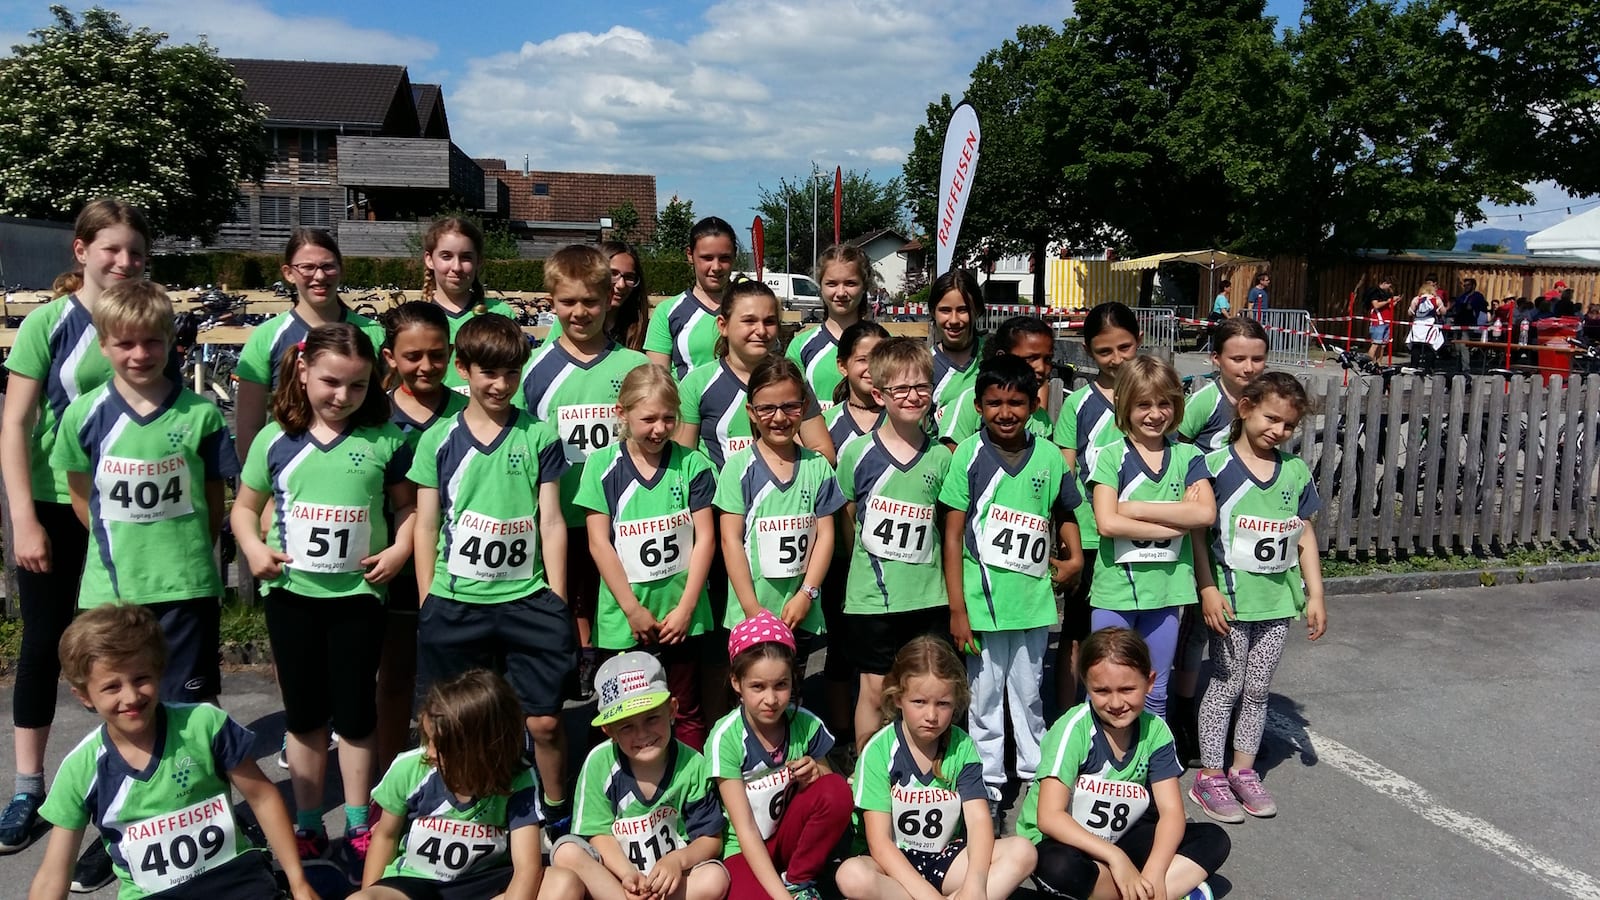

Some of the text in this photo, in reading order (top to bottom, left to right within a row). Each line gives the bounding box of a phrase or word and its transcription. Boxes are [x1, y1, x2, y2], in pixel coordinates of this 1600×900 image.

[938, 130, 977, 247] RAIFFEISEN
[103, 456, 185, 476] RAIFFEISEN
[109, 475, 183, 509] 404
[461, 514, 534, 536] RAIFFEISEN
[619, 512, 691, 537] RAIFFEISEN
[873, 518, 927, 551] 411
[306, 527, 350, 558] 51
[459, 535, 527, 569] 408
[640, 534, 680, 567] 65
[779, 534, 809, 564] 59
[991, 528, 1046, 564] 410
[1139, 550, 1157, 558] Jugitag
[1254, 536, 1289, 562] 61
[1076, 776, 1147, 800] RAIFFEISEN
[127, 799, 225, 841] RAIFFEISEN
[417, 816, 503, 838] RAIFFEISEN
[898, 808, 943, 839] 68
[1086, 799, 1130, 832] 58
[141, 825, 225, 877] 409
[416, 836, 496, 870] 407
[629, 824, 676, 871] 413
[170, 873, 193, 885] Jugitag
